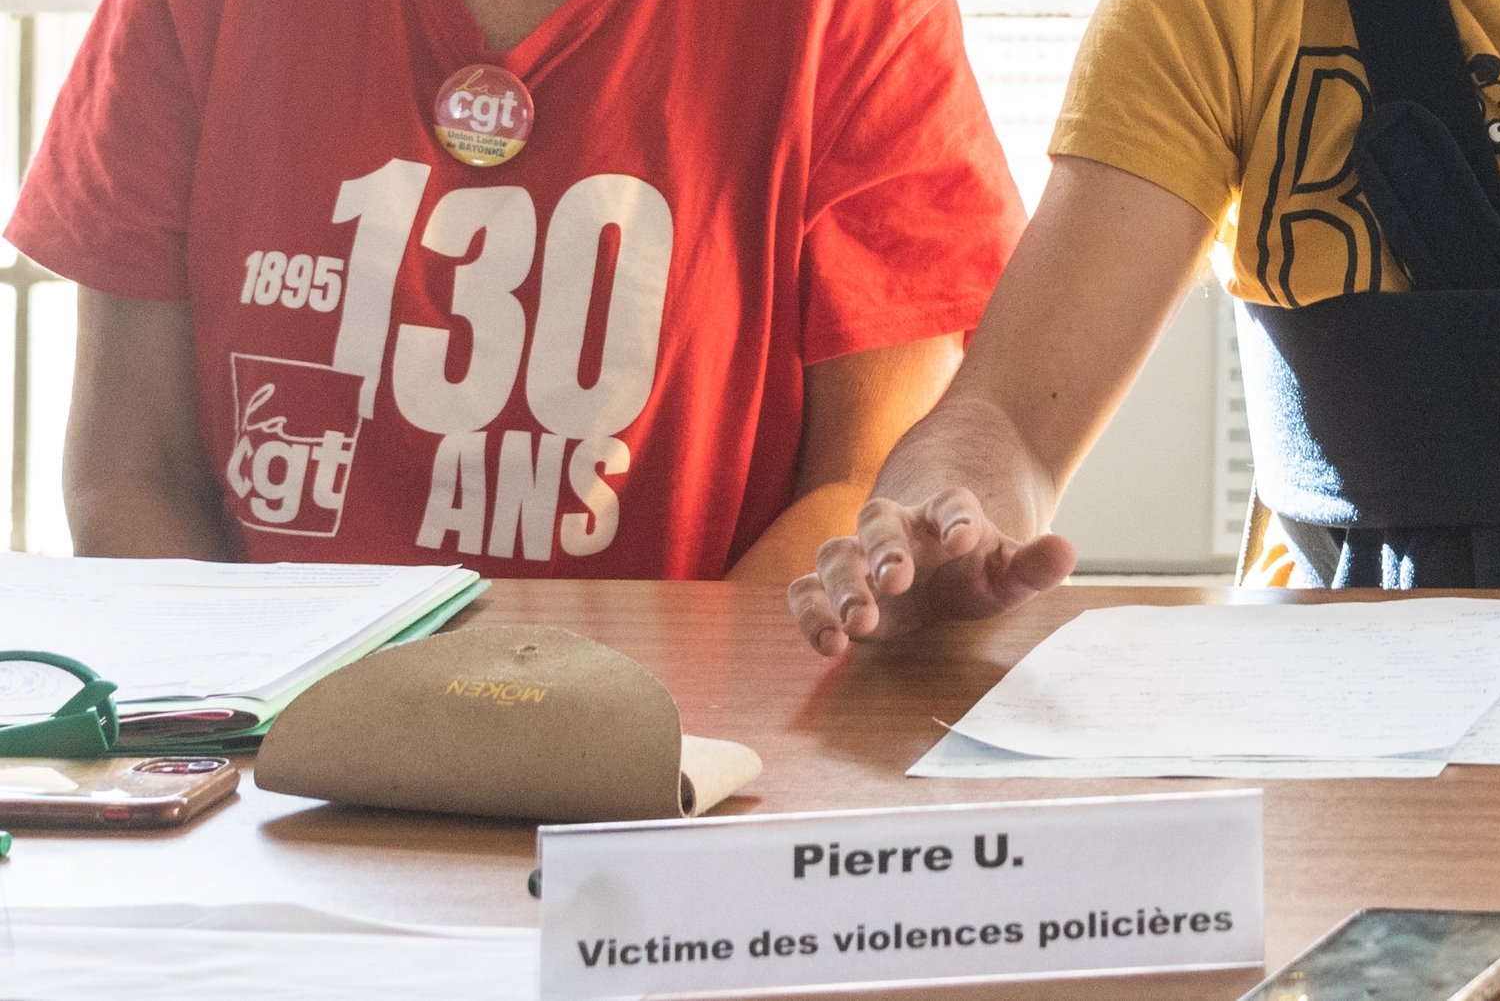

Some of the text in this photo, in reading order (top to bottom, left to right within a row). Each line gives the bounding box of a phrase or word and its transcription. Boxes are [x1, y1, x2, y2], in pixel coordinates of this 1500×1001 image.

[447, 129, 508, 148] Union Locale
[448, 90, 518, 132] cgt
[458, 142, 506, 158] BAYONNE
[240, 250, 346, 313] 1895
[332, 157, 675, 440] 130
[227, 430, 353, 524] cgt
[415, 430, 632, 562] ANS
[792, 833, 1024, 880] Pierre U.
[576, 906, 1234, 968] Victime des violences policières
